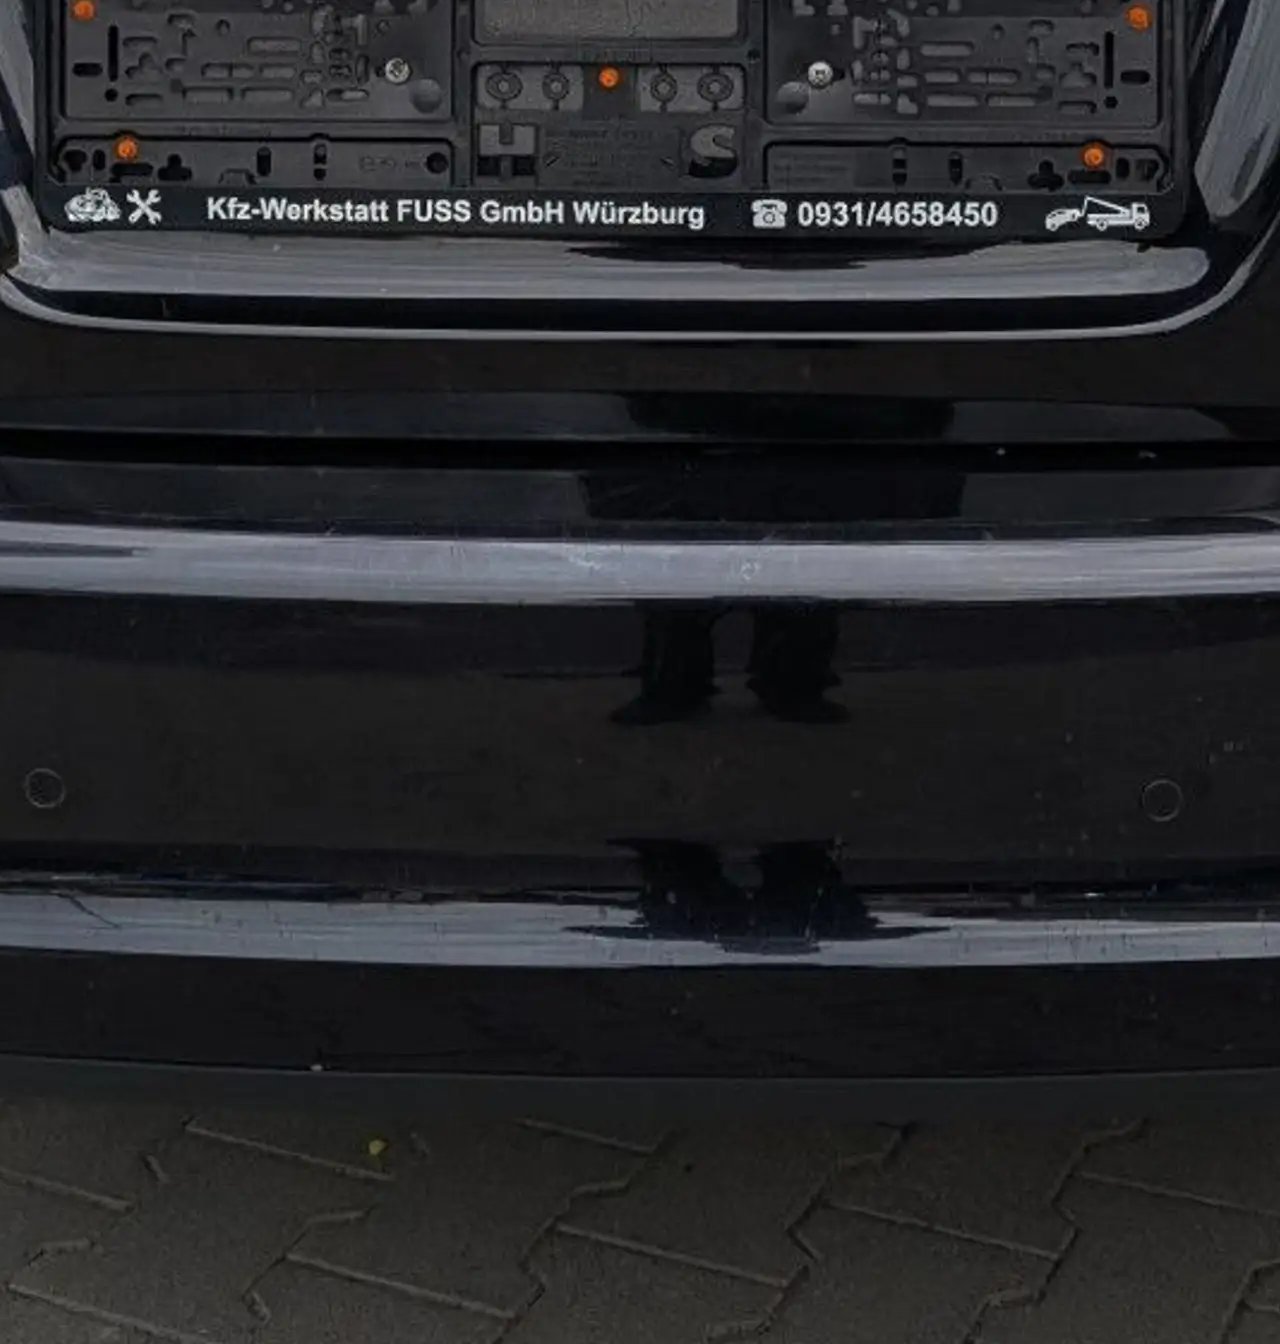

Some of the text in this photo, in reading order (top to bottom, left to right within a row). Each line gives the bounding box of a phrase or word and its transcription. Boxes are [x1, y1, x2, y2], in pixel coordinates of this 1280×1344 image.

[207, 196, 998, 230] Kfz-Werkstatt FUSS GmbH Würzburg 0931/4658450
